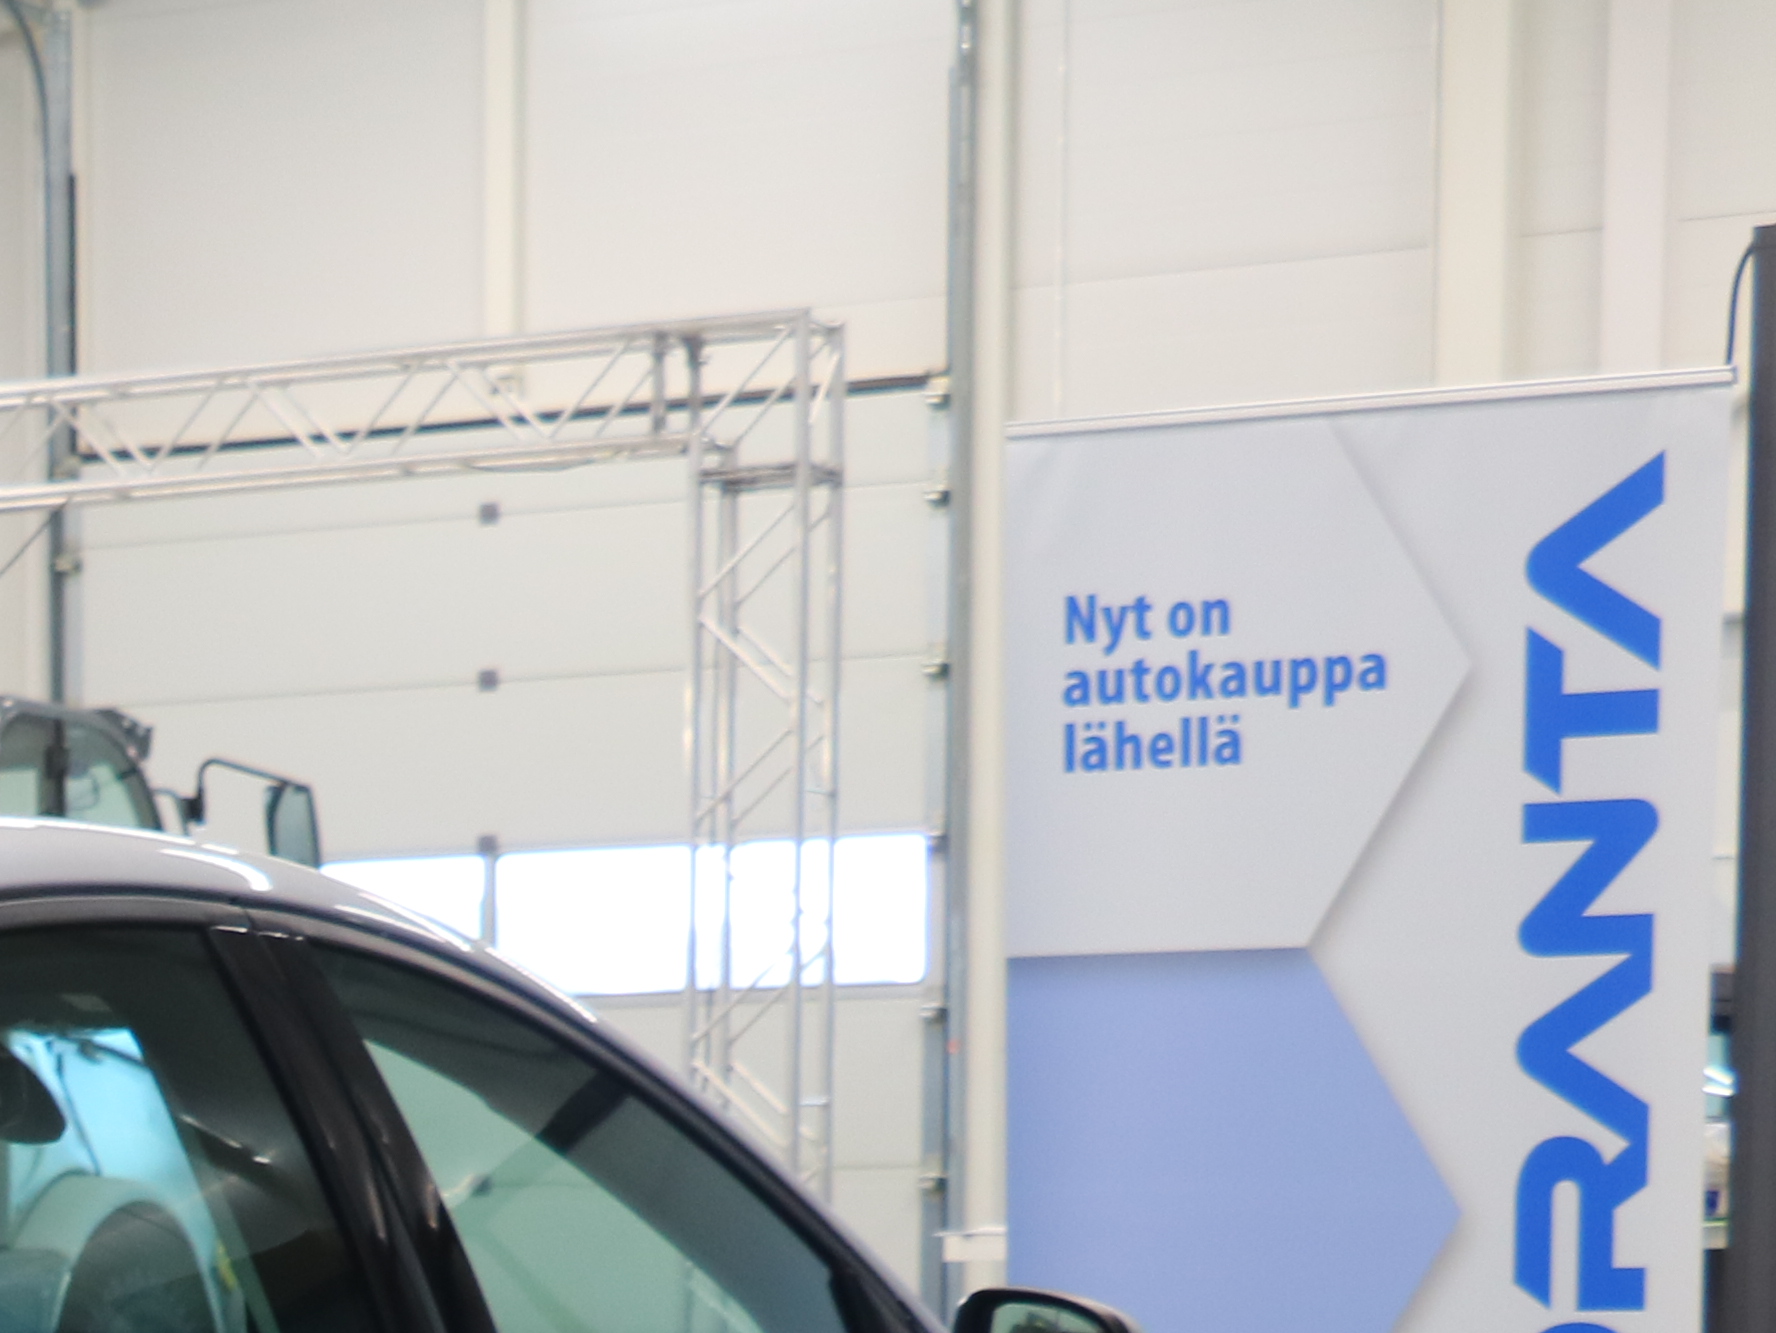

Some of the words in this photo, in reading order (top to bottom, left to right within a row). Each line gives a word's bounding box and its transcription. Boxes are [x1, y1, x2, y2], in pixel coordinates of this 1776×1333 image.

[1063, 594, 1153, 655] Nyt
[1167, 598, 1232, 639] on
[1062, 650, 1389, 708] autokauppa
[1062, 714, 1243, 774] lähellä
